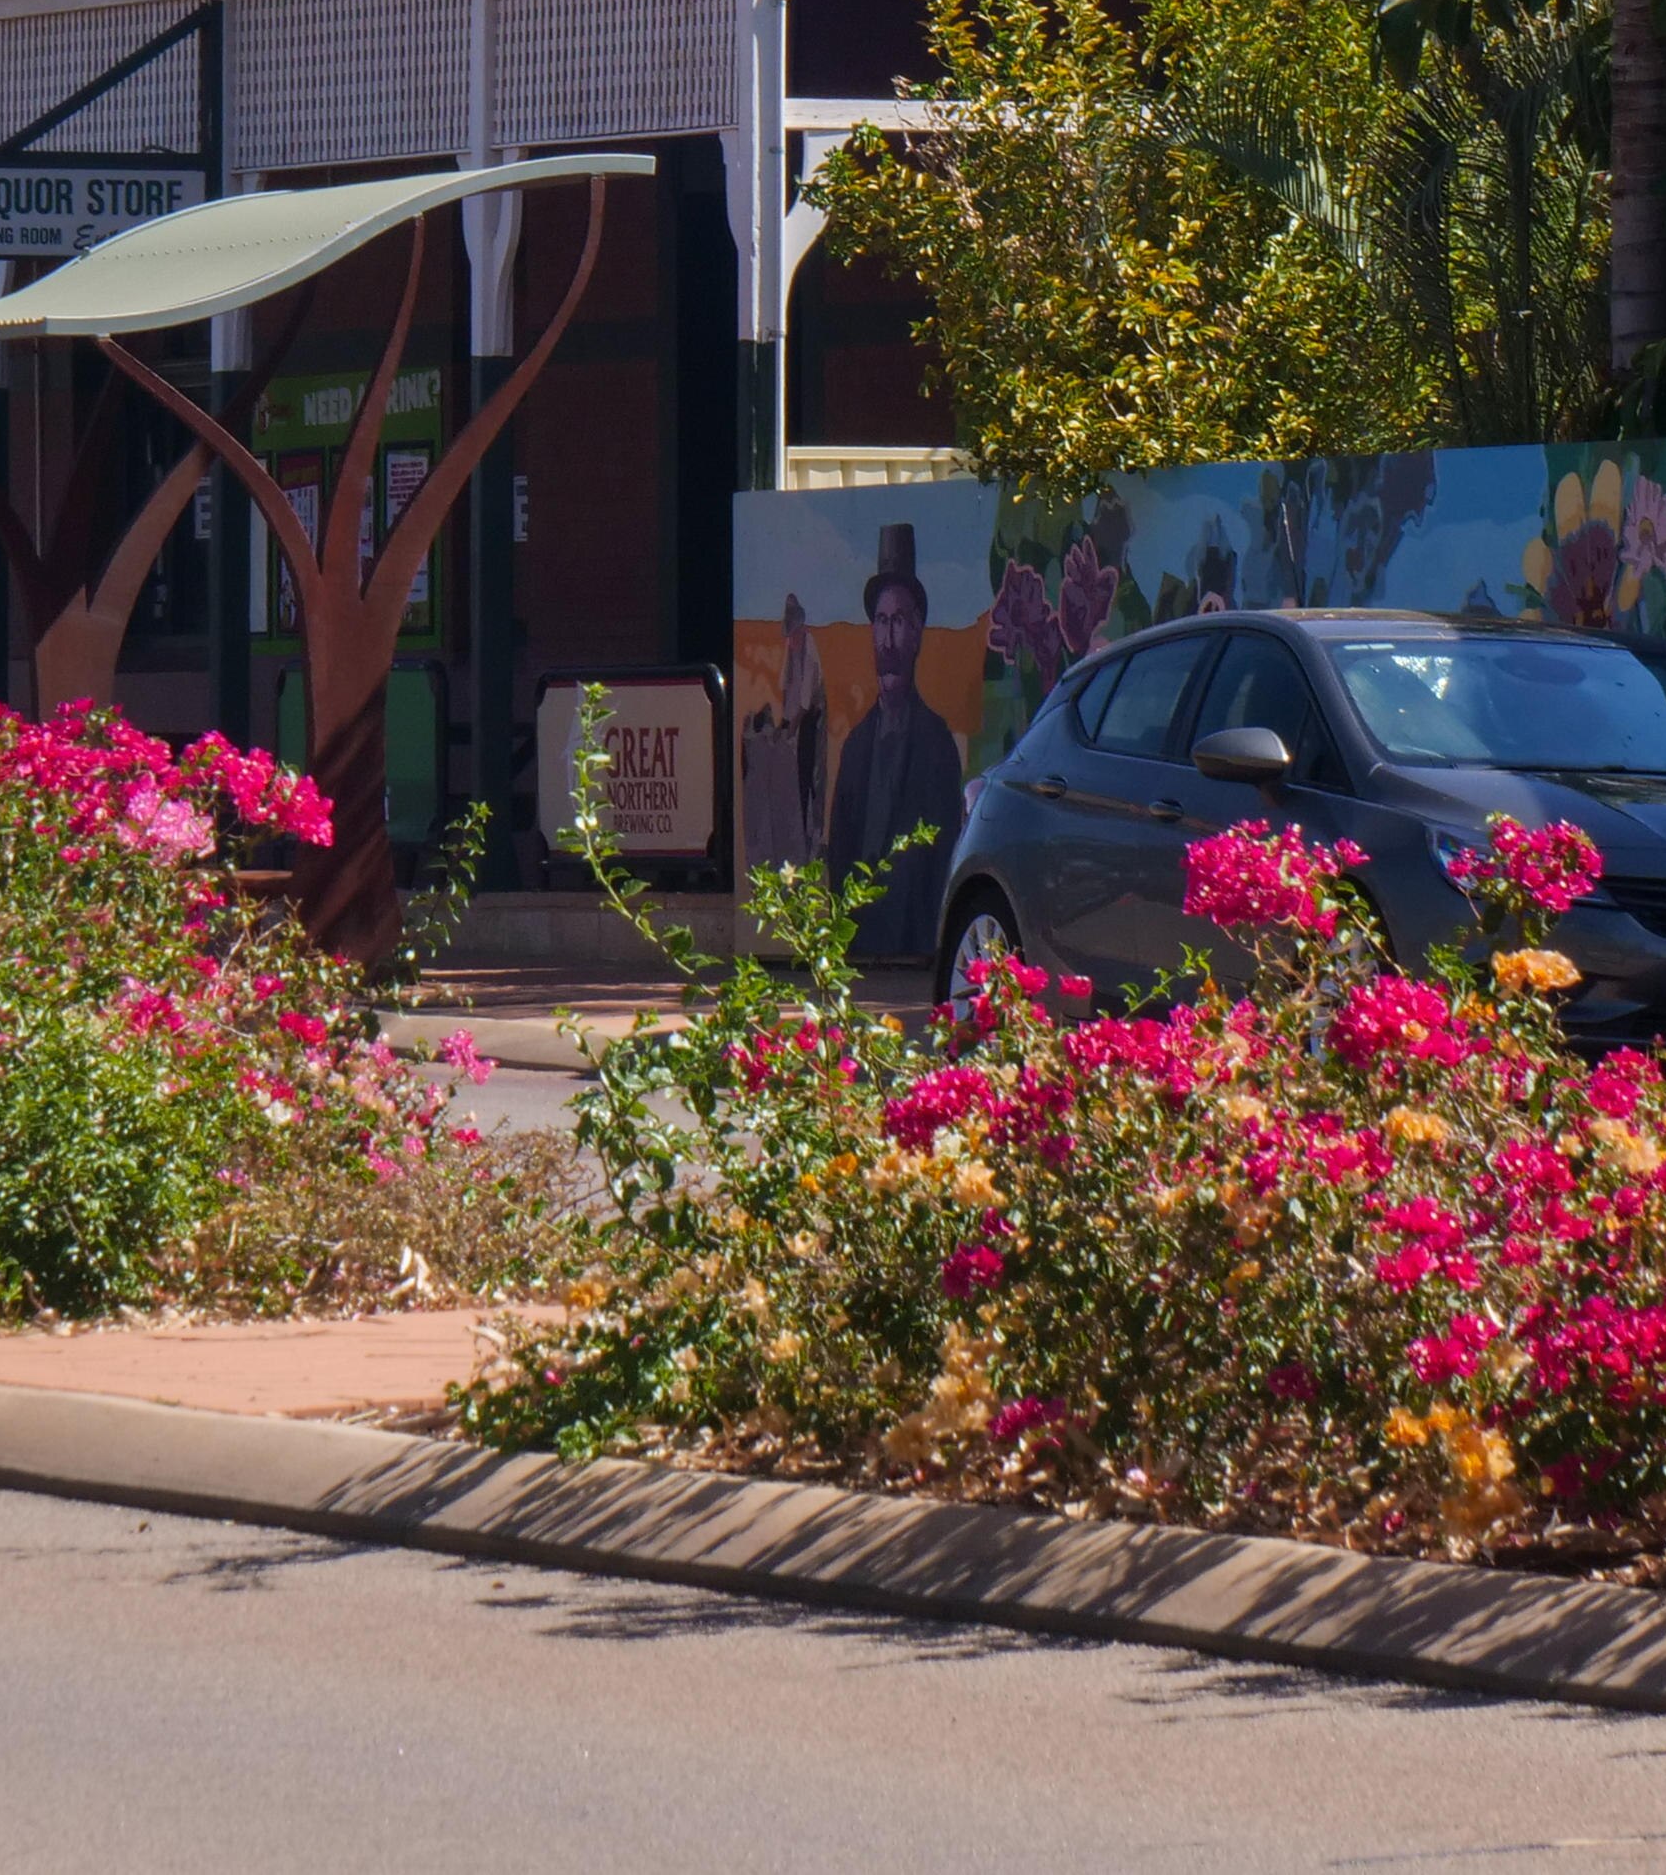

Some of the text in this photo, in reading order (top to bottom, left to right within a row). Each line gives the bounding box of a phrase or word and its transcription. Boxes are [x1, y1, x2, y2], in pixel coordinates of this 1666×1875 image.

[87, 178, 183, 216] STORE
[20, 227, 62, 245] ROOM
[303, 387, 353, 426] NEED
[386, 369, 441, 415] RINK?
[604, 727, 679, 779] GREAT
[607, 781, 679, 810] NORTHERN
[614, 814, 674, 834] BREWING CO.
